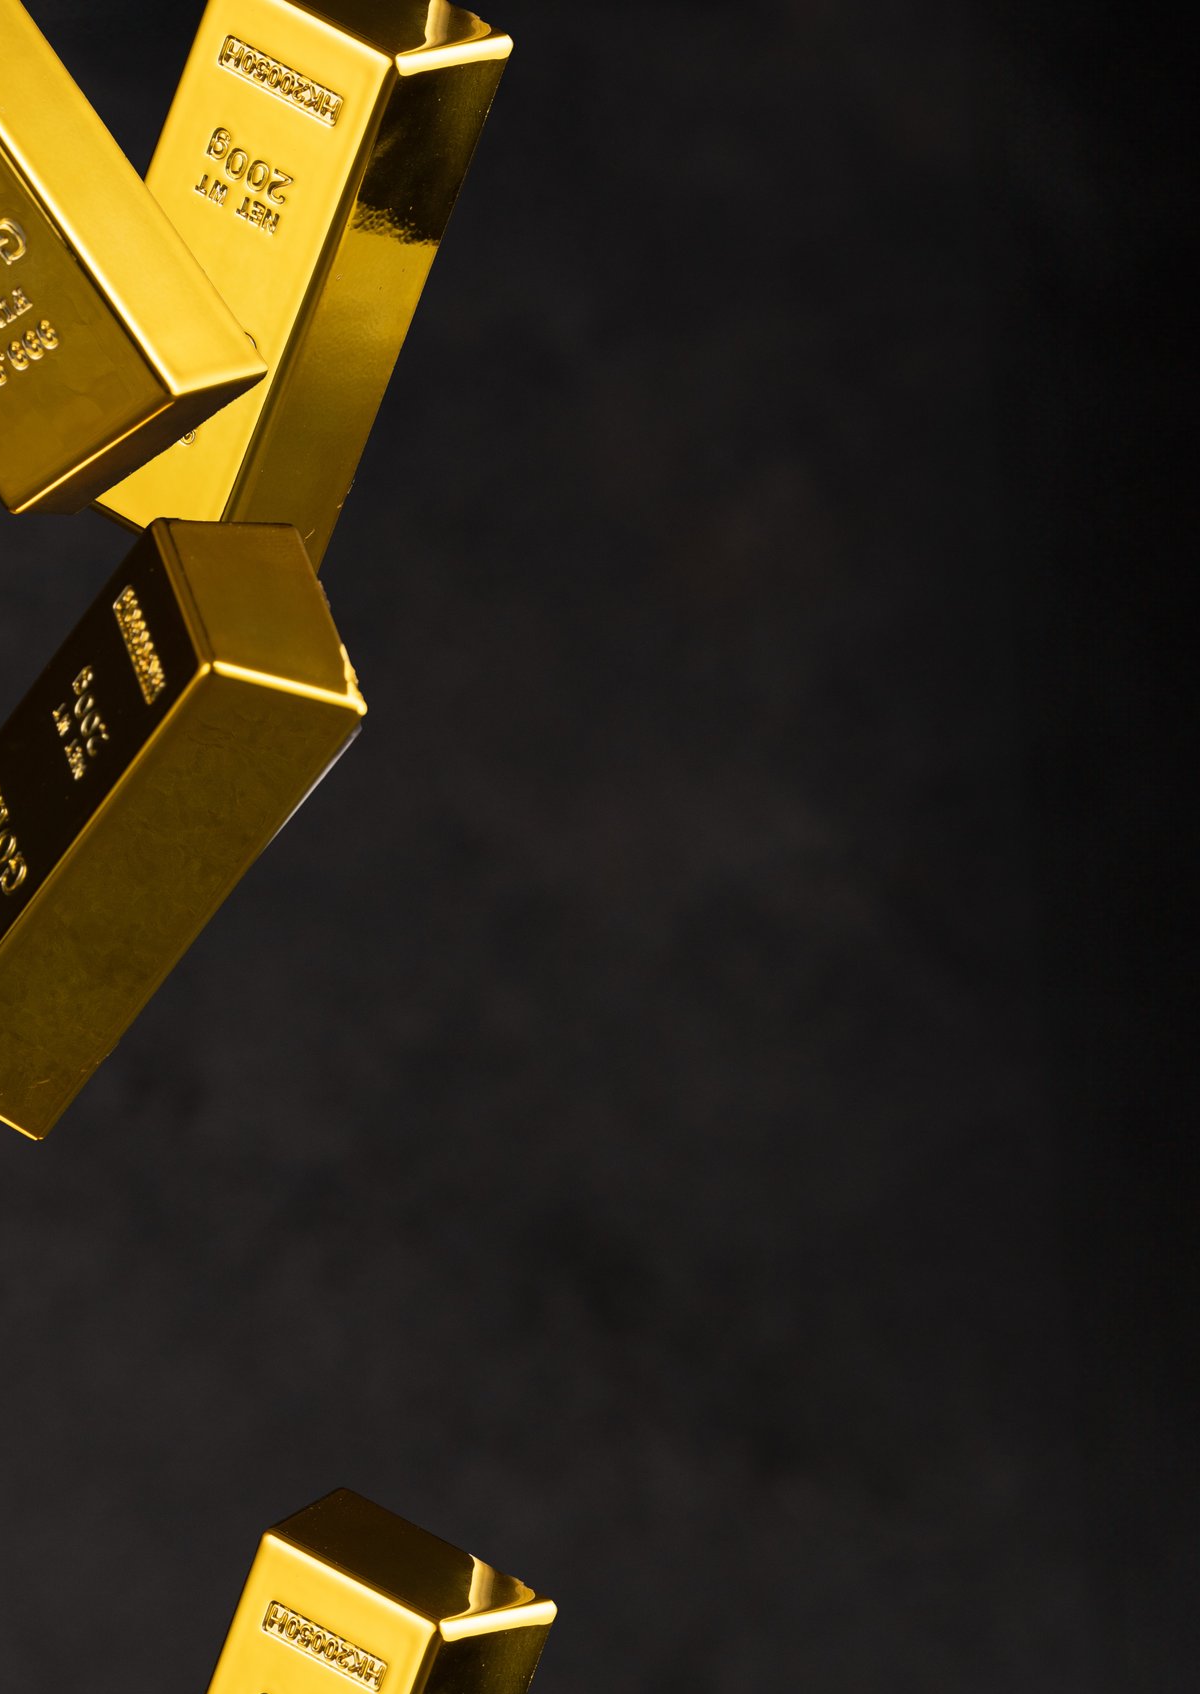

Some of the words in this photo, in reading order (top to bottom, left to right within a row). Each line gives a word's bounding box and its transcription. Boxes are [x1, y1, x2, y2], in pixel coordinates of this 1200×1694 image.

[224, 40, 340, 123] HK20050H
[194, 173, 228, 207] WT
[206, 127, 294, 205] 200g
[236, 196, 281, 235] NET
[267, 1606, 386, 1687] HK20050H
